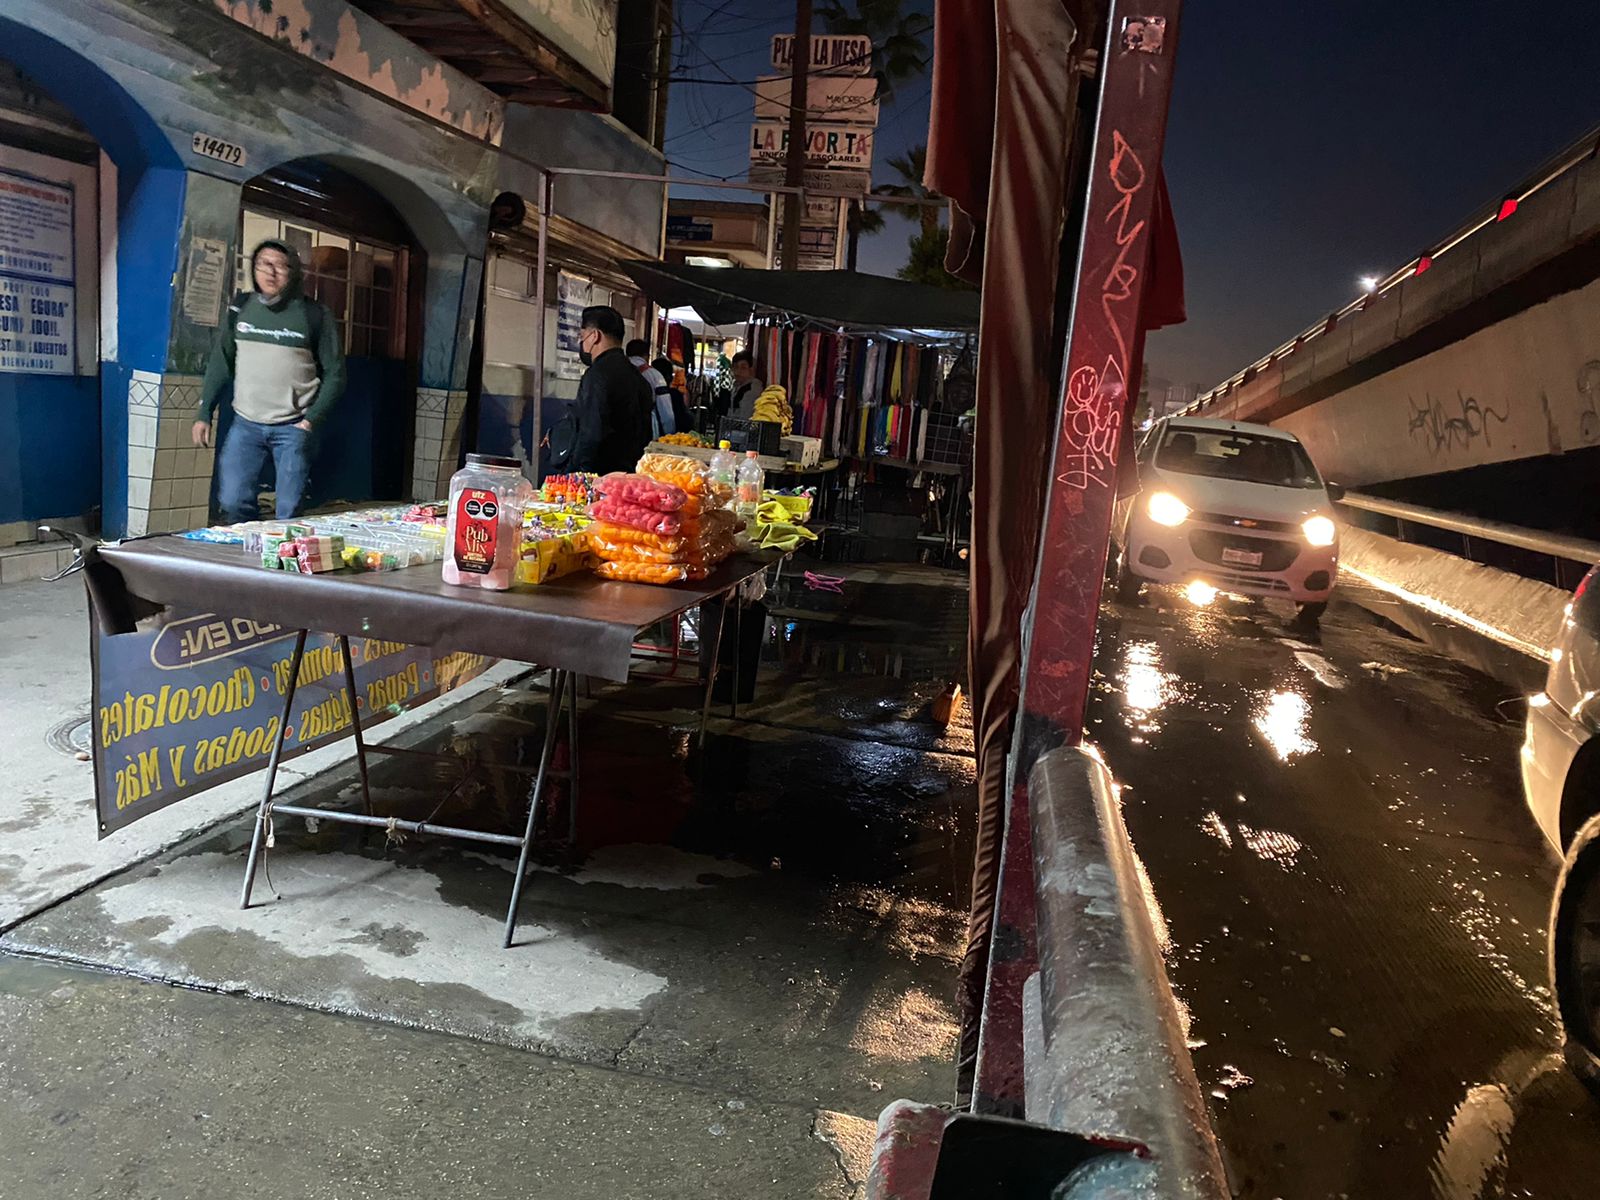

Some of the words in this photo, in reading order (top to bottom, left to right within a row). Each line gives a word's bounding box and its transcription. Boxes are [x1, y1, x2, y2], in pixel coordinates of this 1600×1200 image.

[773, 38, 796, 64] PLA
[813, 39, 828, 65] LA
[832, 40, 867, 66] MESA
[753, 128, 775, 150] LA
[781, 129, 868, 155] FVORTA
[811, 154, 861, 162] ESCOLARES
[4, 282, 50, 297] PROTCOLO
[465, 525, 489, 542] Pub
